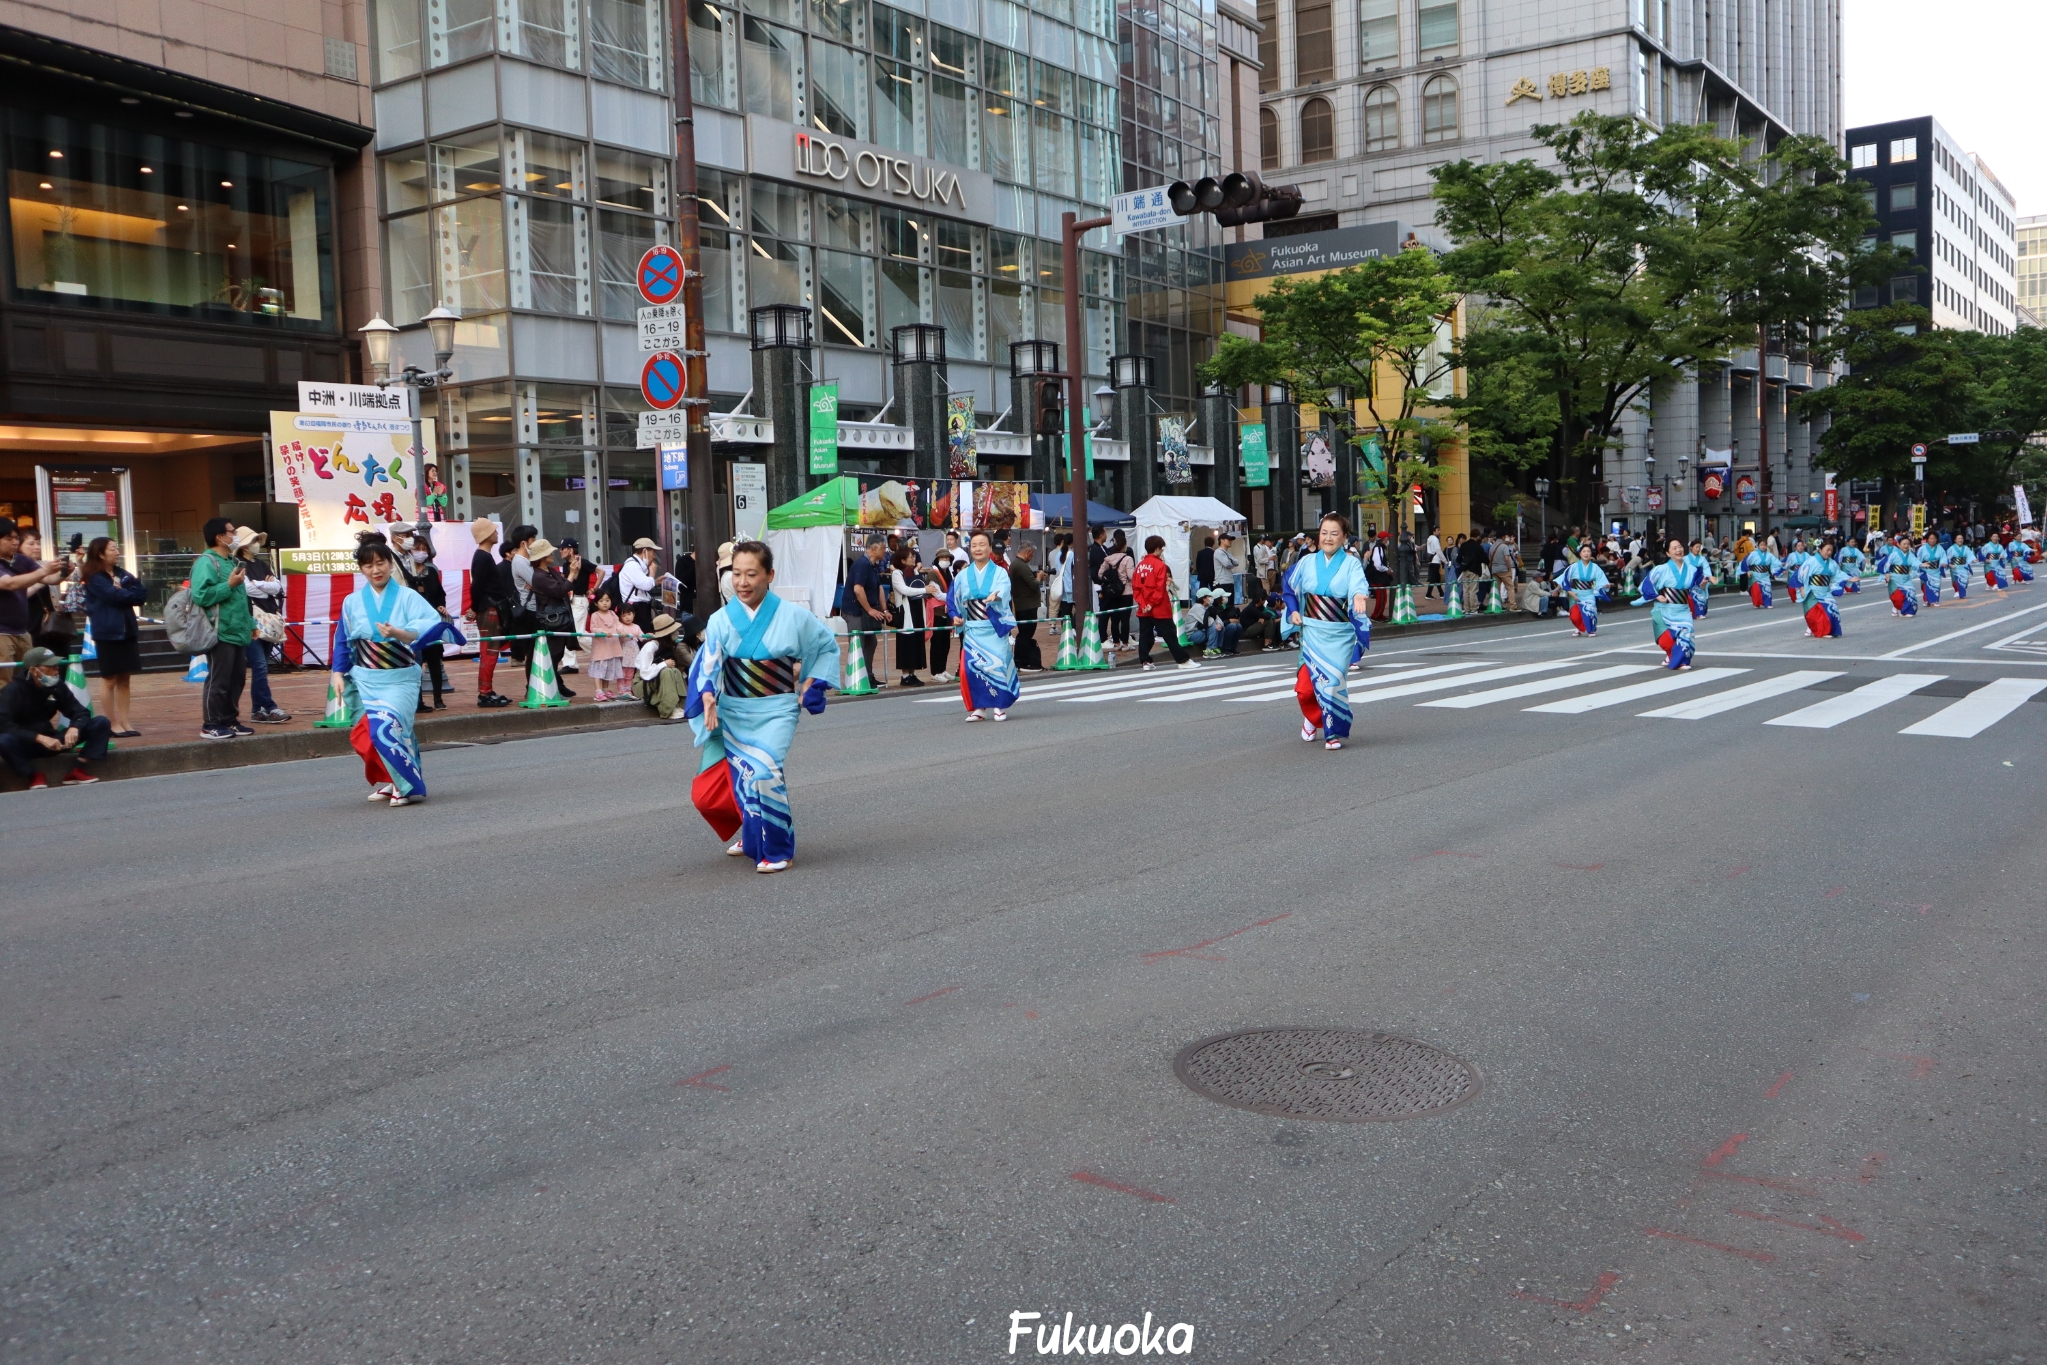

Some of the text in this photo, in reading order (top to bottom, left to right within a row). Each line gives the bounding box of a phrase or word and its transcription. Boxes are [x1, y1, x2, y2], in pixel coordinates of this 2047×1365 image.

[1547, 66, 1610, 97] 博多座
[795, 133, 966, 210] IDC OTSUKA
[1117, 191, 1163, 213] 川端通
[1127, 208, 1171, 221] Kawabata-dori
[1132, 216, 1167, 228] INTERSECTION
[1270, 243, 1318, 257] Fukuoka
[1272, 248, 1379, 270] Asian Art Museum
[641, 305, 682, 320] 人の乗降を除く
[644, 336, 680, 350] ここから
[308, 389, 401, 410] 中洲・川端拠点
[645, 428, 681, 441] ここから
[813, 438, 835, 446] Fukuoka
[663, 452, 685, 463] 地下鉄
[308, 442, 407, 489] どんたく
[813, 462, 836, 470] Museum
[344, 492, 402, 525] 広場
[738, 495, 745, 509] 6
[1871, 507, 1879, 527] 横断場
